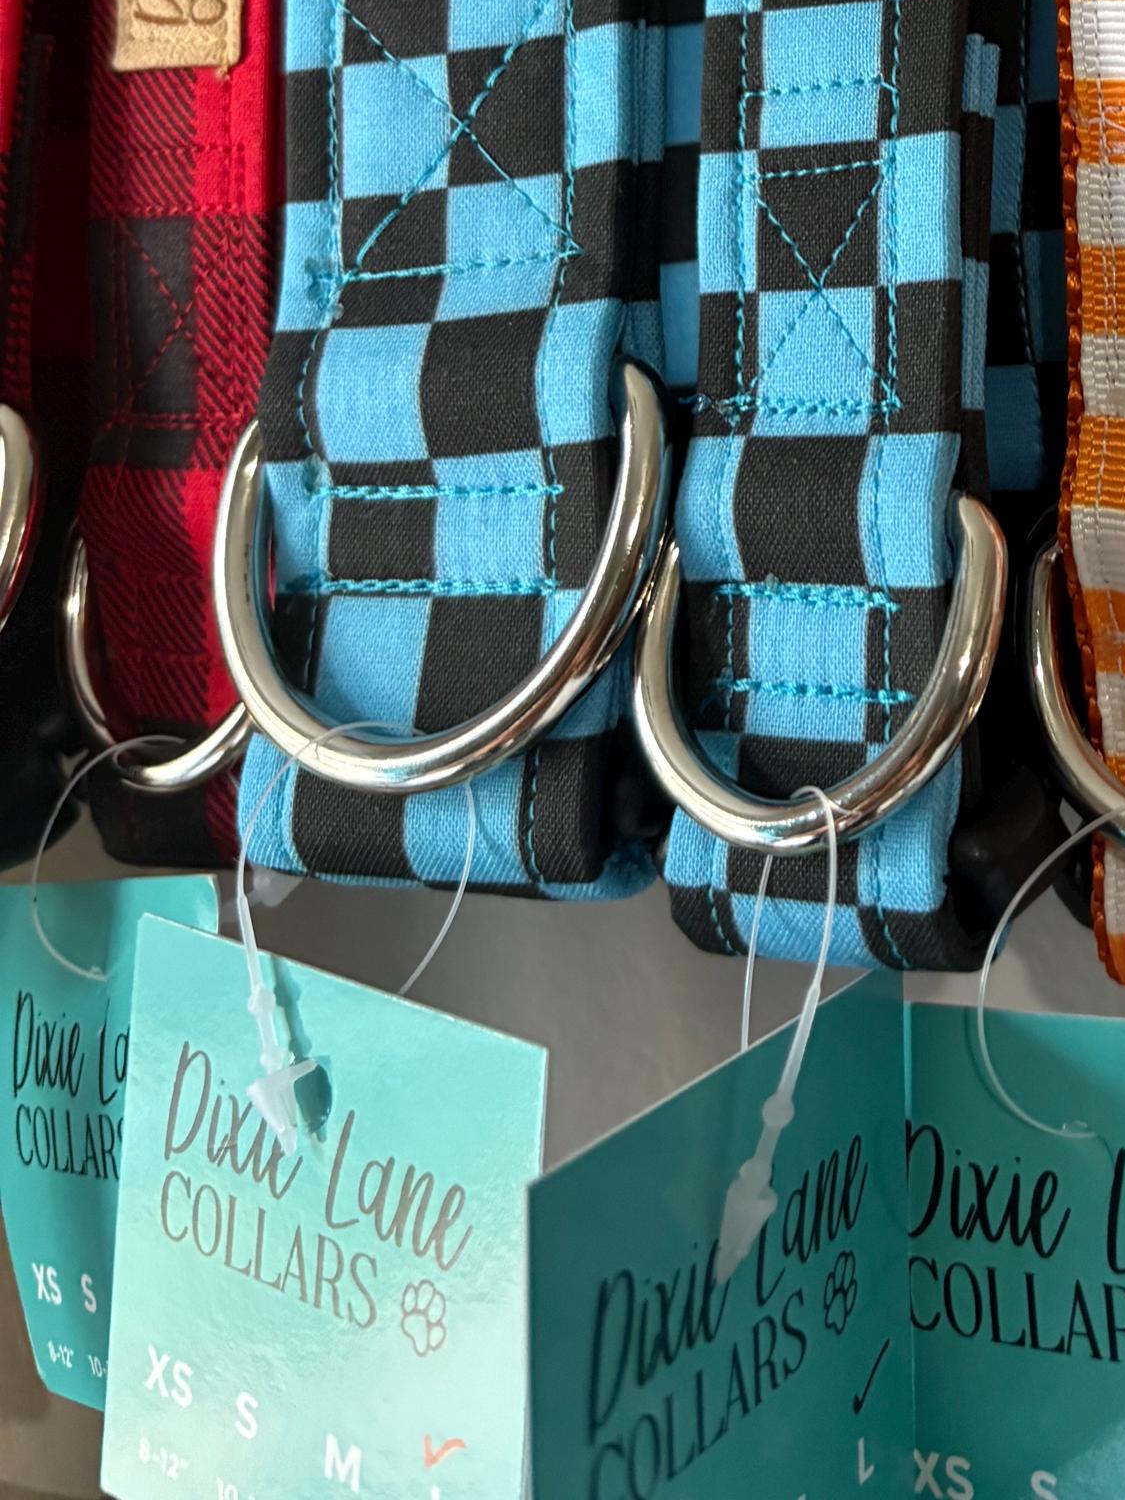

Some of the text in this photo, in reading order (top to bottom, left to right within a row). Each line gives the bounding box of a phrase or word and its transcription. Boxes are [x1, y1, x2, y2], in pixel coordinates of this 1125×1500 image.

[13, 989, 85, 1098] Dixie
[161, 1171, 379, 1329] COLLARS
[325, 1109, 473, 1271] Lane
[905, 1119, 1071, 1259] Dixie
[32, 1262, 97, 1314] XS S
[145, 1345, 193, 1408] XS
[235, 1391, 258, 1439] S
[324, 1433, 361, 1492] M
[588, 1288, 807, 1500] COLLARS
[858, 1437, 874, 1484] L
[913, 1448, 975, 1500] XS
